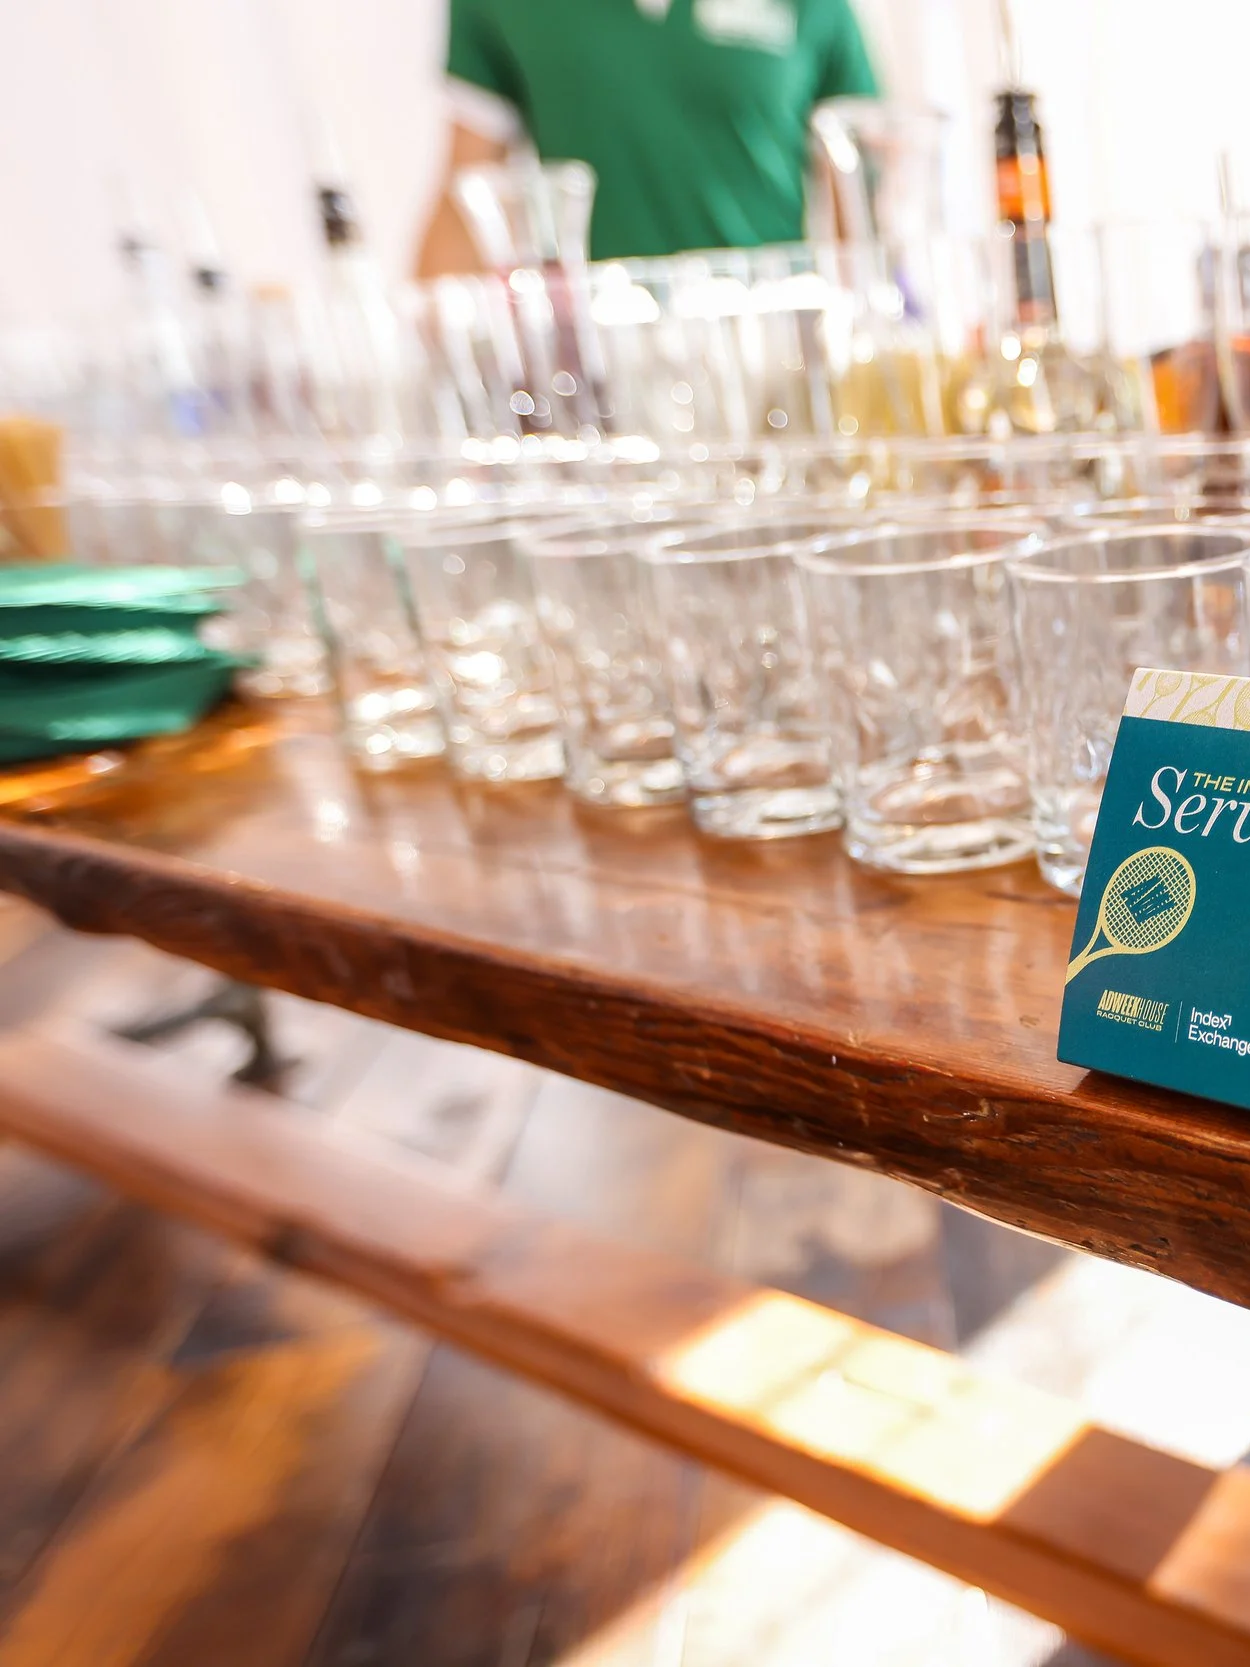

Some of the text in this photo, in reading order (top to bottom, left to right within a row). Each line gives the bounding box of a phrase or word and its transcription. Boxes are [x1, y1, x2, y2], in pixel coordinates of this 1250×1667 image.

[1193, 772, 1236, 792] THE
[1095, 1009, 1163, 1032] RACQUET CLUB
[1190, 1006, 1230, 1030] Index
